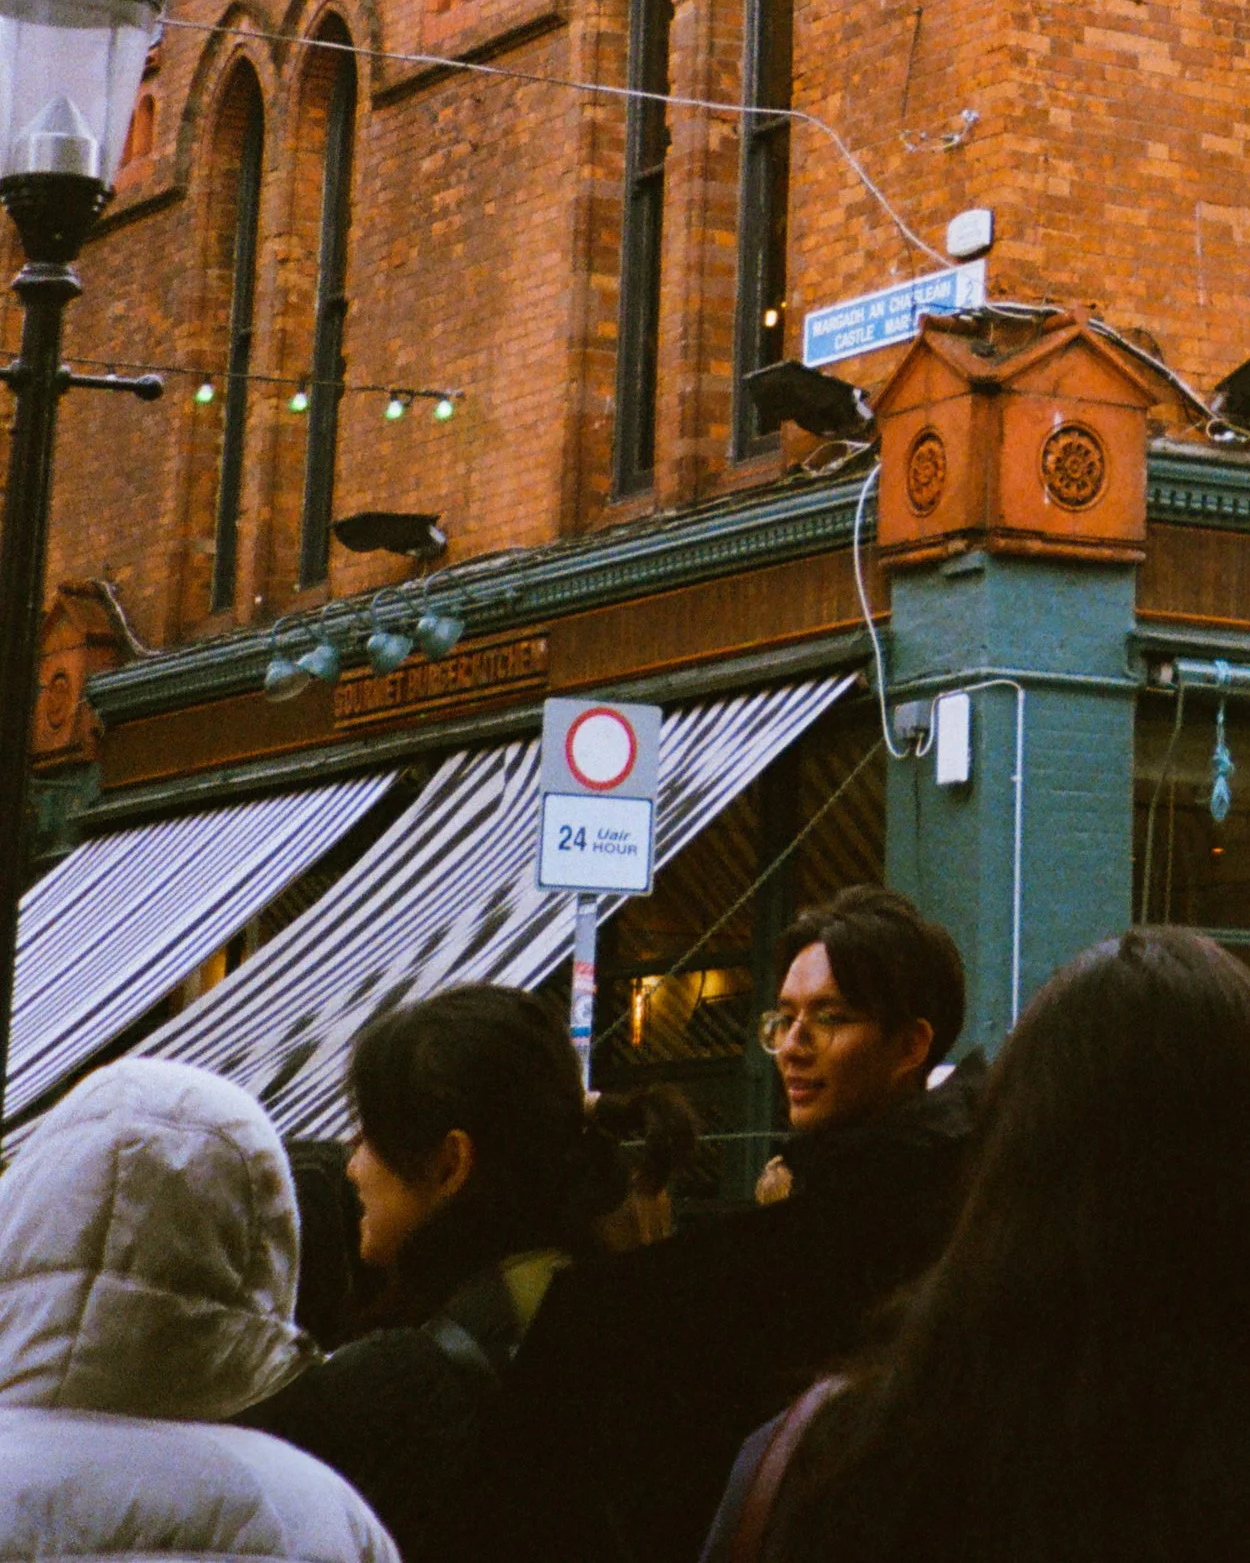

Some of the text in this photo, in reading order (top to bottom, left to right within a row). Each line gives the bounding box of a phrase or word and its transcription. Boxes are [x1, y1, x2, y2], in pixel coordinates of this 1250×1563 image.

[869, 300, 885, 320] AN
[889, 278, 951, 314] CHASLEÁIN
[964, 281, 975, 305] 2
[834, 324, 876, 351] CASTLE
[558, 824, 632, 852] 24 Uair
[592, 842, 638, 857] HOUR
